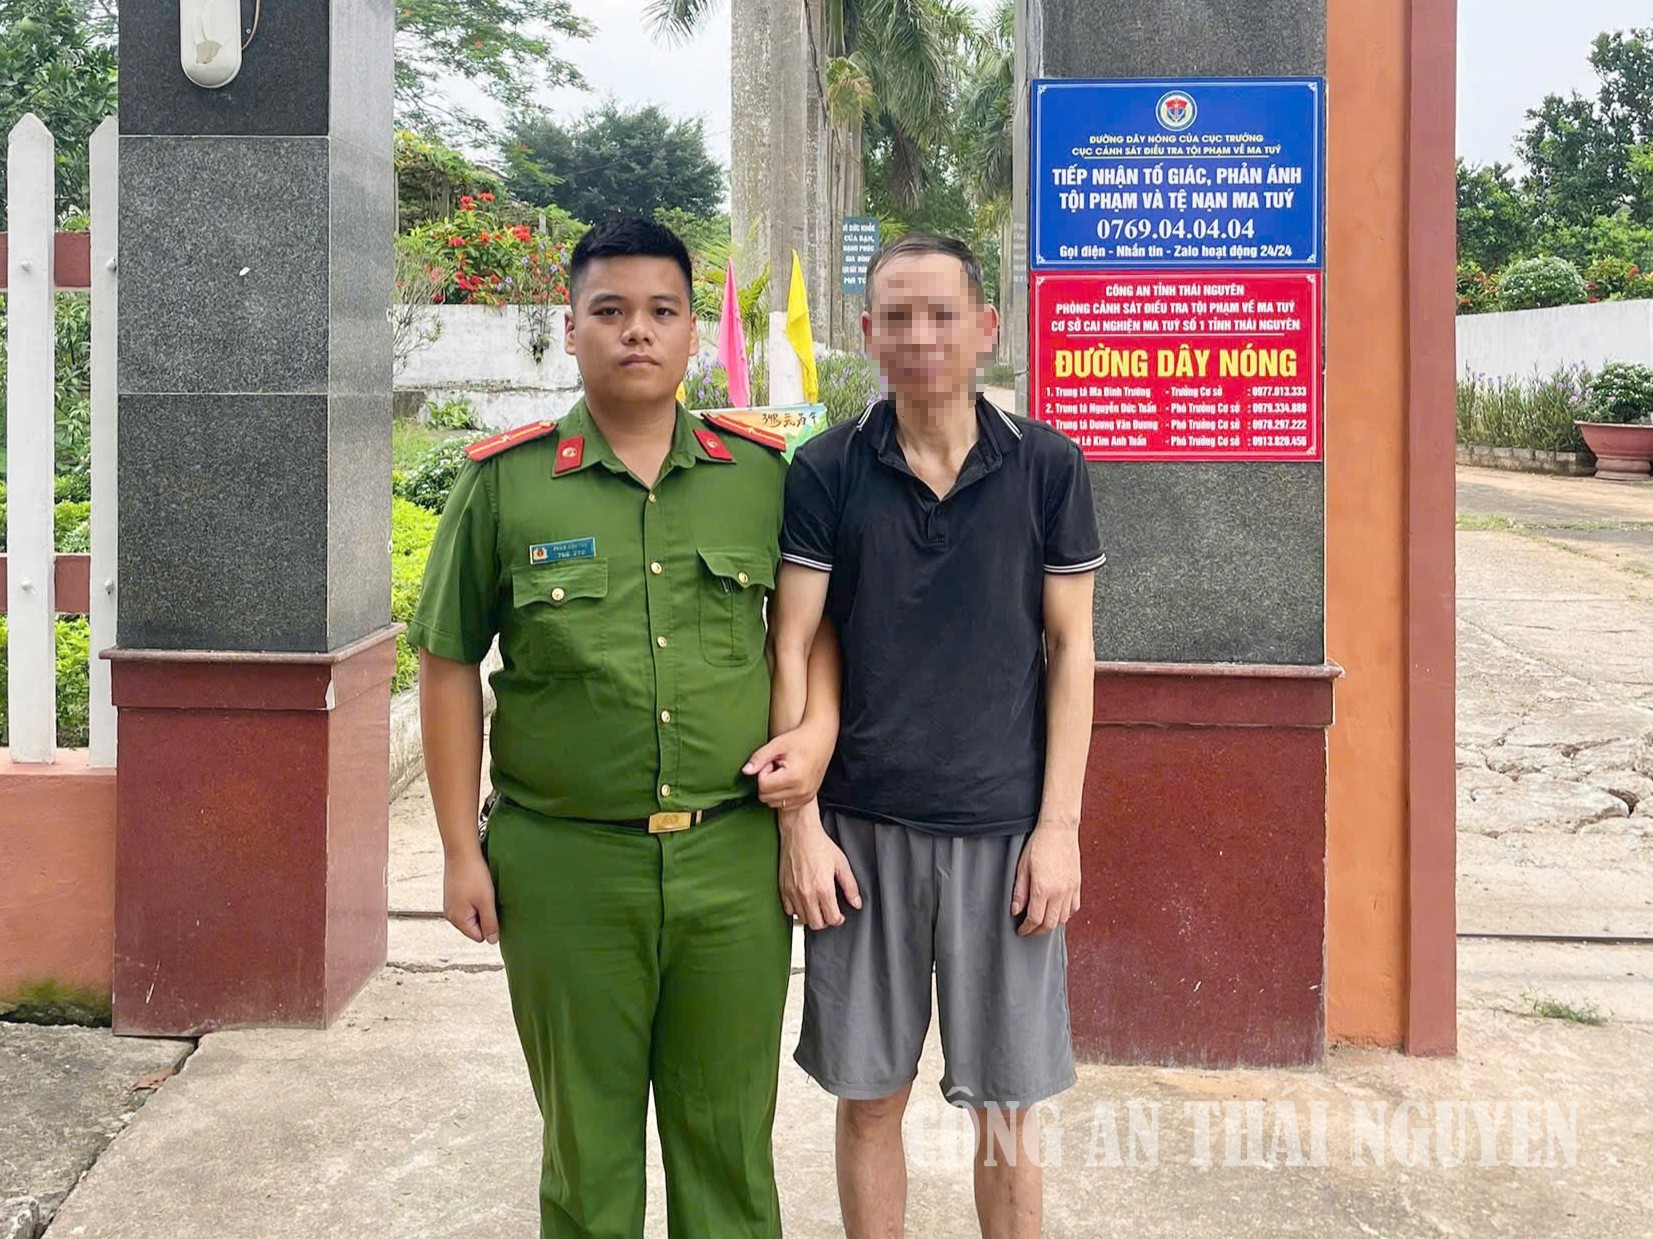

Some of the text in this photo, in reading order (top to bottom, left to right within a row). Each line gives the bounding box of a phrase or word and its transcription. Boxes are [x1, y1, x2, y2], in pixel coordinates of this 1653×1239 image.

[1090, 133, 1124, 143] ĐƯỜNG
[1126, 133, 1145, 143] DÂY
[1148, 133, 1176, 143] NÓNG
[1179, 133, 1199, 143] CỦA
[1202, 135, 1222, 145] CỤC
[1072, 148, 1092, 156] CỤC
[1095, 145, 1122, 155] CẢNH
[1125, 145, 1141, 155] SÁT
[1186, 145, 1201, 156] TỘI
[1203, 147, 1230, 156] PHẠM
[1053, 162, 1301, 188] TIẾP NHẬN TỐ GIÁC, PHẢN ÁNH
[1060, 189, 1294, 212] TỘI PHẠM VÀ TỆ NẠN MA TUÝ
[1097, 219, 1254, 239] 0769.04.04.04
[1060, 246, 1078, 259] Gọi
[1081, 245, 1105, 259] điện
[1117, 243, 1145, 257] Nhắn
[1148, 246, 1163, 256] tin
[1174, 245, 1198, 256] Zalo
[1202, 246, 1226, 258] hoạt
[1230, 245, 1257, 258] động
[1260, 245, 1291, 256] 24/24
[1105, 282, 1245, 297] CÔNG AN TỈNH THÁI NGUYÊN
[1056, 302, 1090, 314] PHÒNG
[1093, 300, 1120, 314] CẢNH
[1123, 302, 1142, 313] SÁT
[1170, 303, 1188, 313] TRA
[1191, 301, 1206, 315] TỘI
[1210, 303, 1239, 315] PHẠM
[1257, 302, 1273, 312] MA
[1052, 321, 1065, 331] CƠ
[1068, 318, 1081, 331] SỞ
[1084, 321, 1100, 331] CAI
[1103, 319, 1140, 333] NGHIỆN
[1143, 321, 1159, 330] MA
[1183, 317, 1196, 331] SỐ
[1200, 321, 1204, 330] 1
[1208, 317, 1231, 330] TỈNH
[1234, 318, 1256, 330] THÁI
[1259, 318, 1300, 330] NGUYÊN
[1055, 343, 1296, 377] ĐƯỜNG DÂY NÓNG
[1046, 387, 1053, 396] 1.
[1055, 387, 1077, 397] Trung
[1090, 387, 1102, 396] Ma
[1046, 403, 1053, 413] 2.
[1056, 403, 1077, 414] Trung
[1056, 420, 1078, 430] Trung
